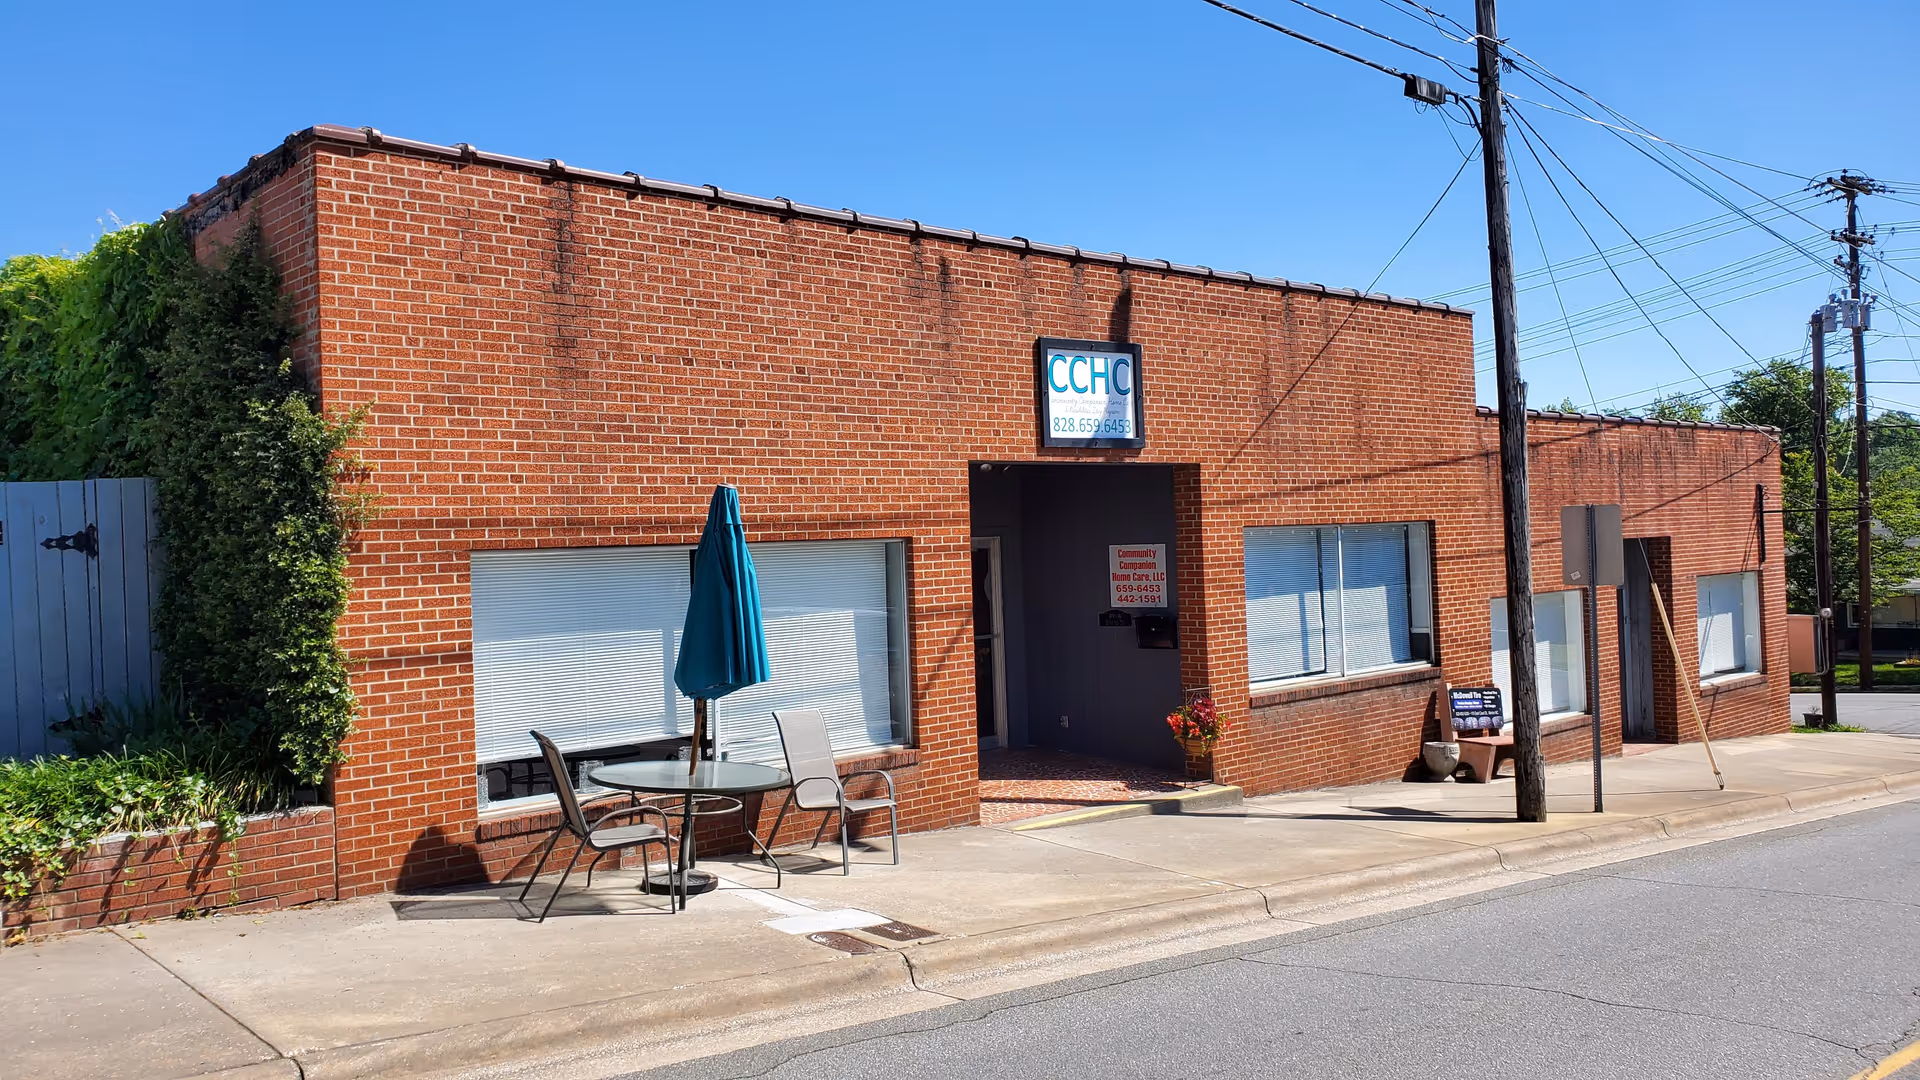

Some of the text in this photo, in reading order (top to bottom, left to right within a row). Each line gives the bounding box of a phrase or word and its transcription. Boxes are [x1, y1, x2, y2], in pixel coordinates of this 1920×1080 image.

[1048, 353, 1131, 396] CCHC
[1053, 416, 1132, 434] 828.659.6453
[1117, 548, 1157, 559] Community
[1119, 560, 1157, 571] Companion
[1112, 572, 1165, 582] Home Care, LLC
[1116, 584, 1161, 593] 659-6453
[1117, 594, 1161, 603] 442-1591
